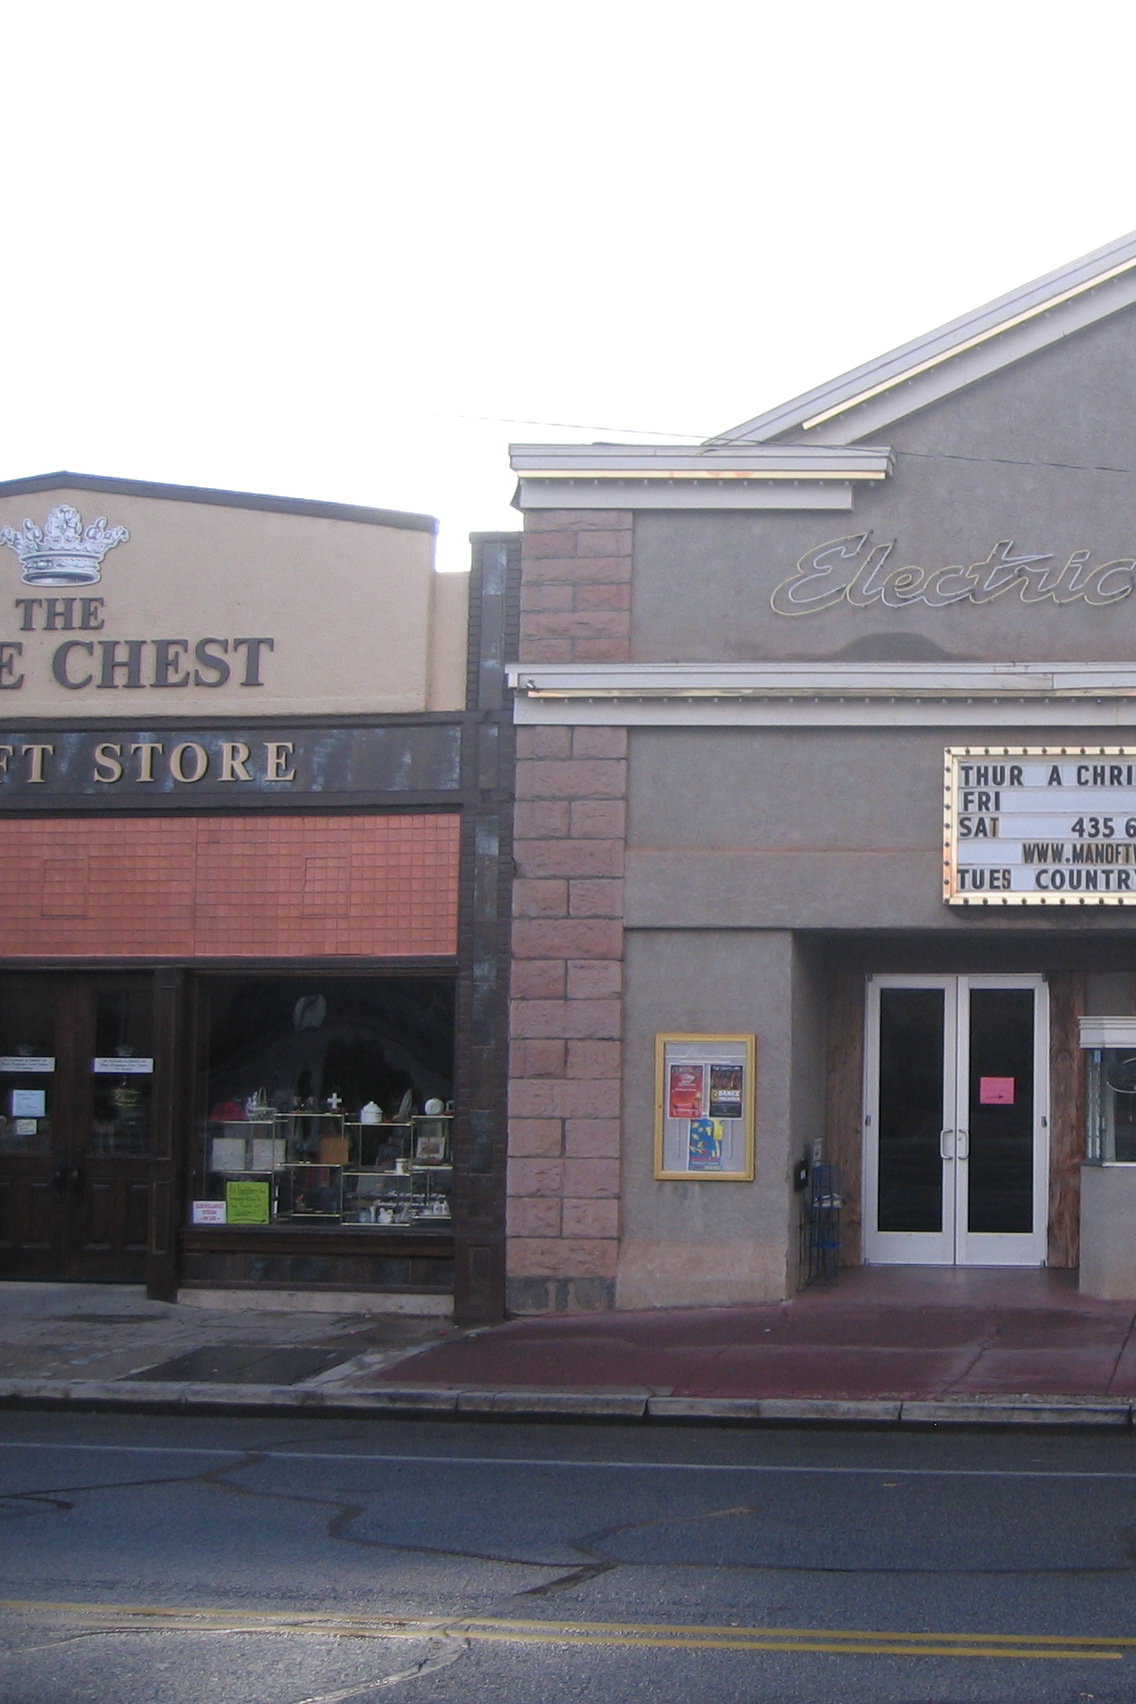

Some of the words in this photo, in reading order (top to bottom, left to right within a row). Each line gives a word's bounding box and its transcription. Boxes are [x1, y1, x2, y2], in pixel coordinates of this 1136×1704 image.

[770, 531, 1136, 615] Electric
[15, 597, 105, 631] THE
[53, 637, 274, 690] CHEST
[93, 741, 297, 784] STORE
[961, 765, 1023, 786] THUR
[1048, 765, 1062, 786] A
[963, 791, 1000, 812] FRI
[959, 817, 999, 837] SAT
[1071, 817, 1115, 838] 435
[958, 869, 1011, 890] TUES
